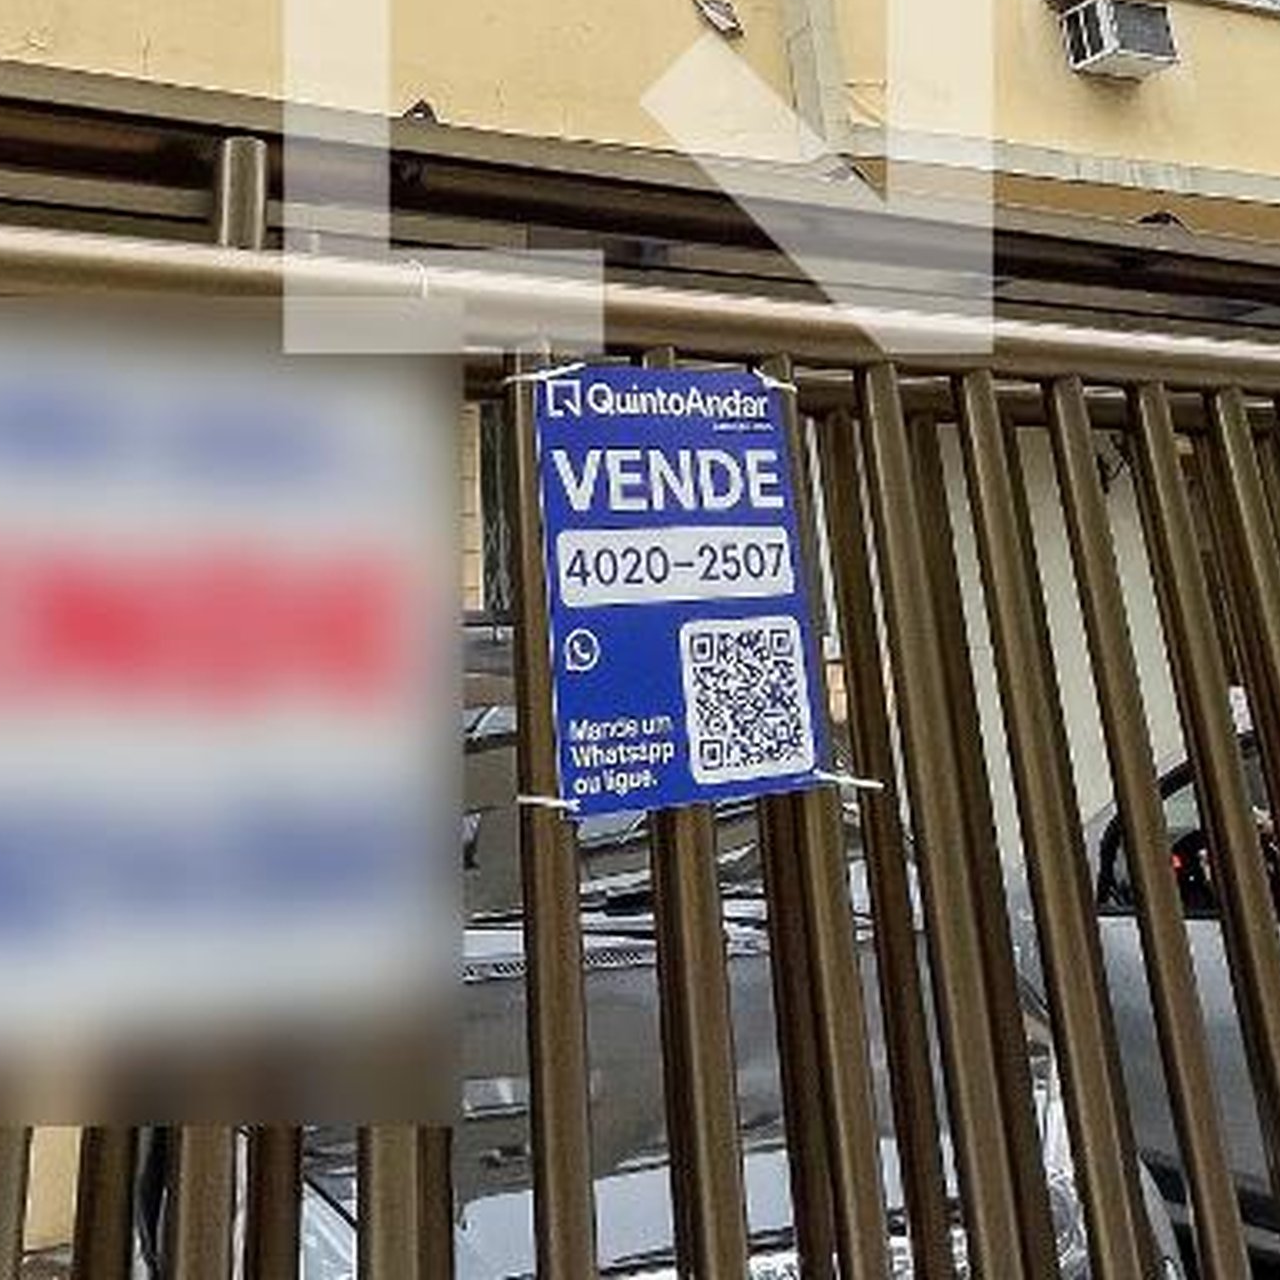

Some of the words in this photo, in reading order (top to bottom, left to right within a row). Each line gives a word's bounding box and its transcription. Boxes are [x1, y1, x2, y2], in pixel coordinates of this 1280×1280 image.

[587, 381, 769, 418] QuintoAndar
[552, 449, 785, 512] VENDE
[566, 542, 785, 587] 4020-2507
[573, 776, 601, 796] ou
